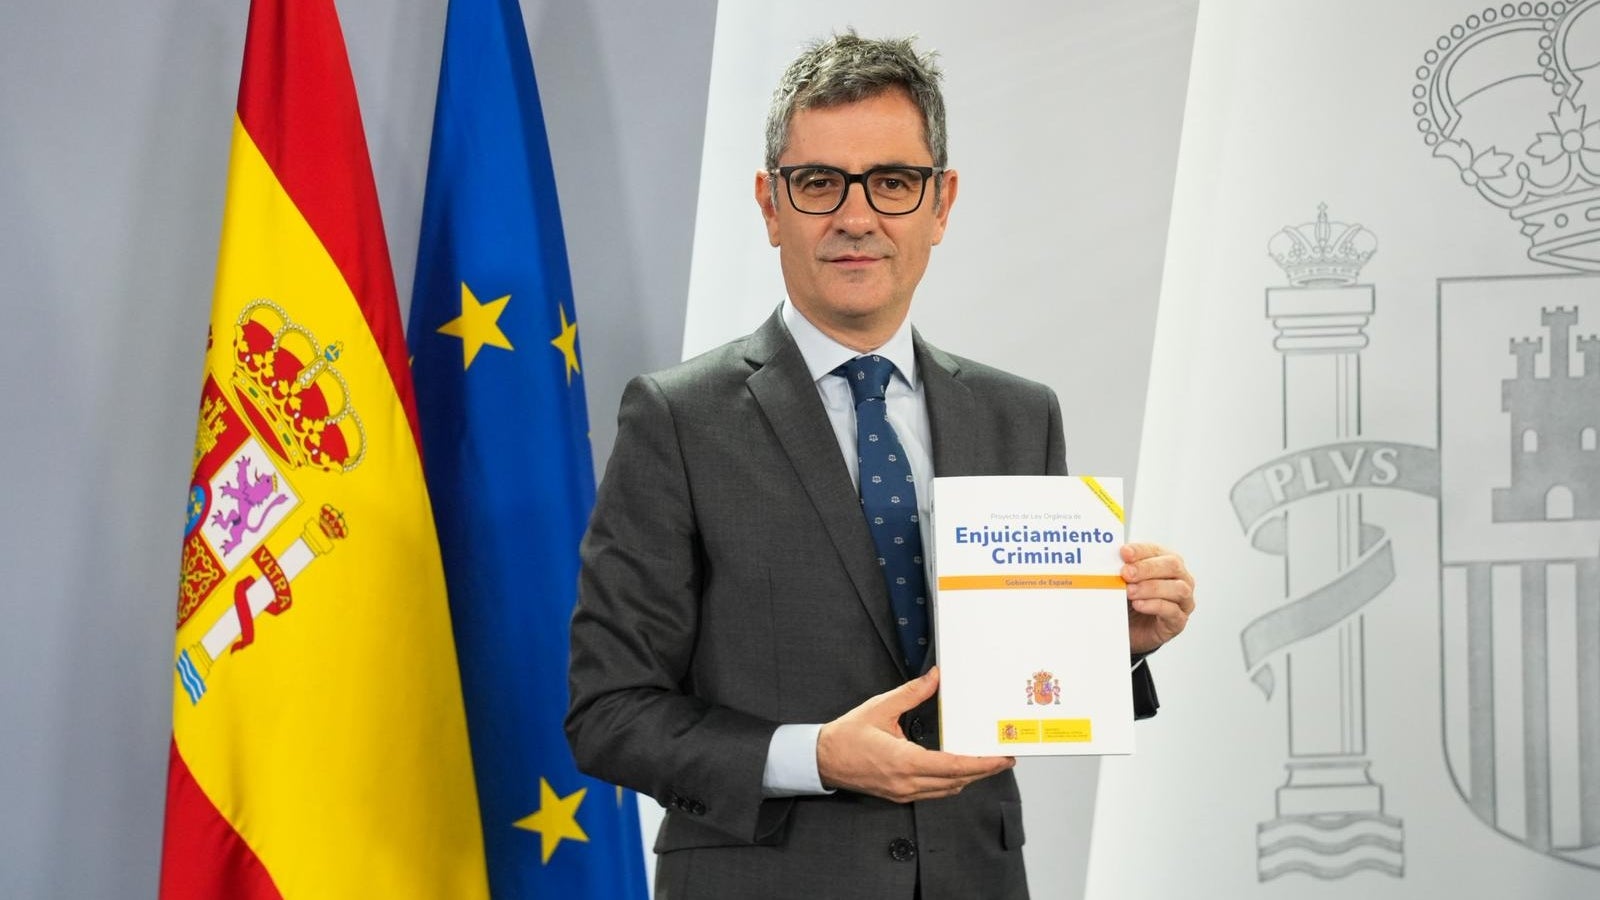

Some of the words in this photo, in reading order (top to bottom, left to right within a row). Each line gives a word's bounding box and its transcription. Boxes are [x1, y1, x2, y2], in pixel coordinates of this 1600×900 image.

[1263, 448, 1398, 503] PLVS
[955, 525, 1114, 547] Enjuiciamiento
[992, 547, 1082, 564] Criminal
[259, 549, 290, 607] VLTRA
[1048, 579, 1073, 587] España
